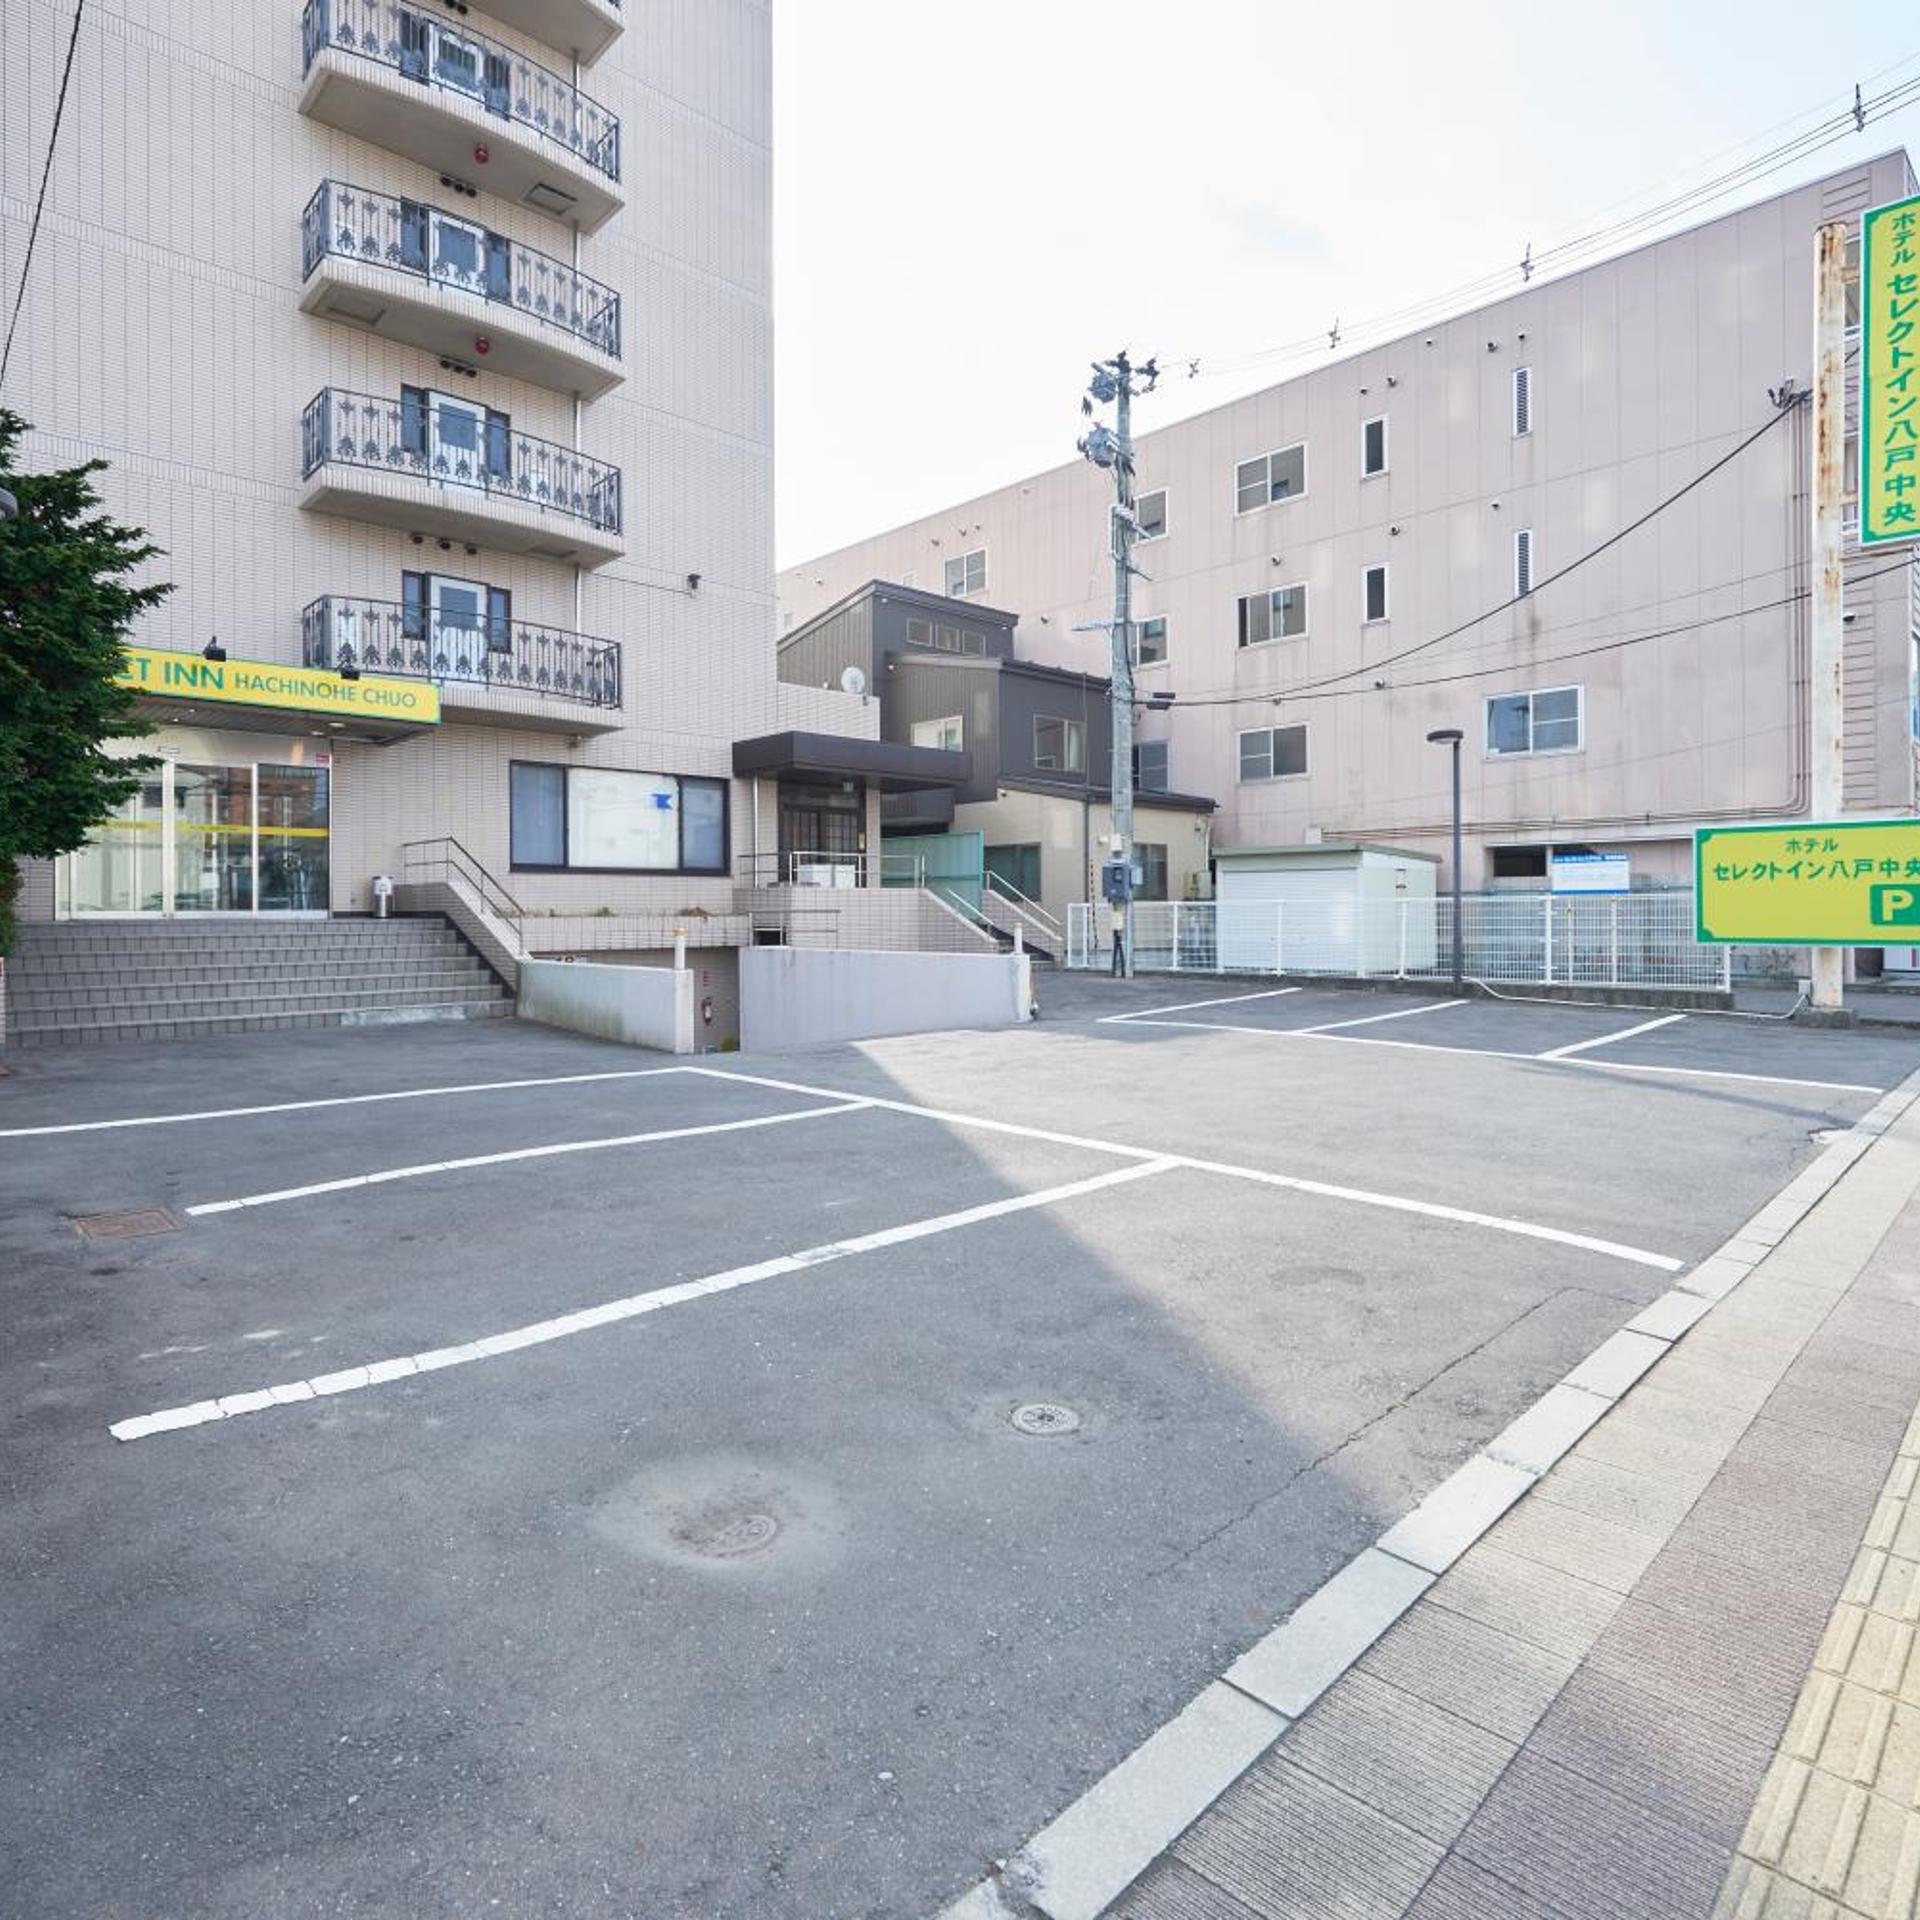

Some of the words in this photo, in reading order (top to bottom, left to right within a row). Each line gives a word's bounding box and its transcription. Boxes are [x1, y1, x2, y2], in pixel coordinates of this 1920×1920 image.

[1891, 213, 1916, 267] ホテル
[1884, 274, 1918, 525] セレクトイン八戸中央
[164, 661, 224, 689] INN
[234, 673, 356, 700] HACHINOHE
[363, 688, 416, 708] CHUO
[1786, 838, 1838, 852] ホテル
[1714, 858, 1920, 880] セレクトイン八戸中央
[1882, 889, 1914, 921] P
